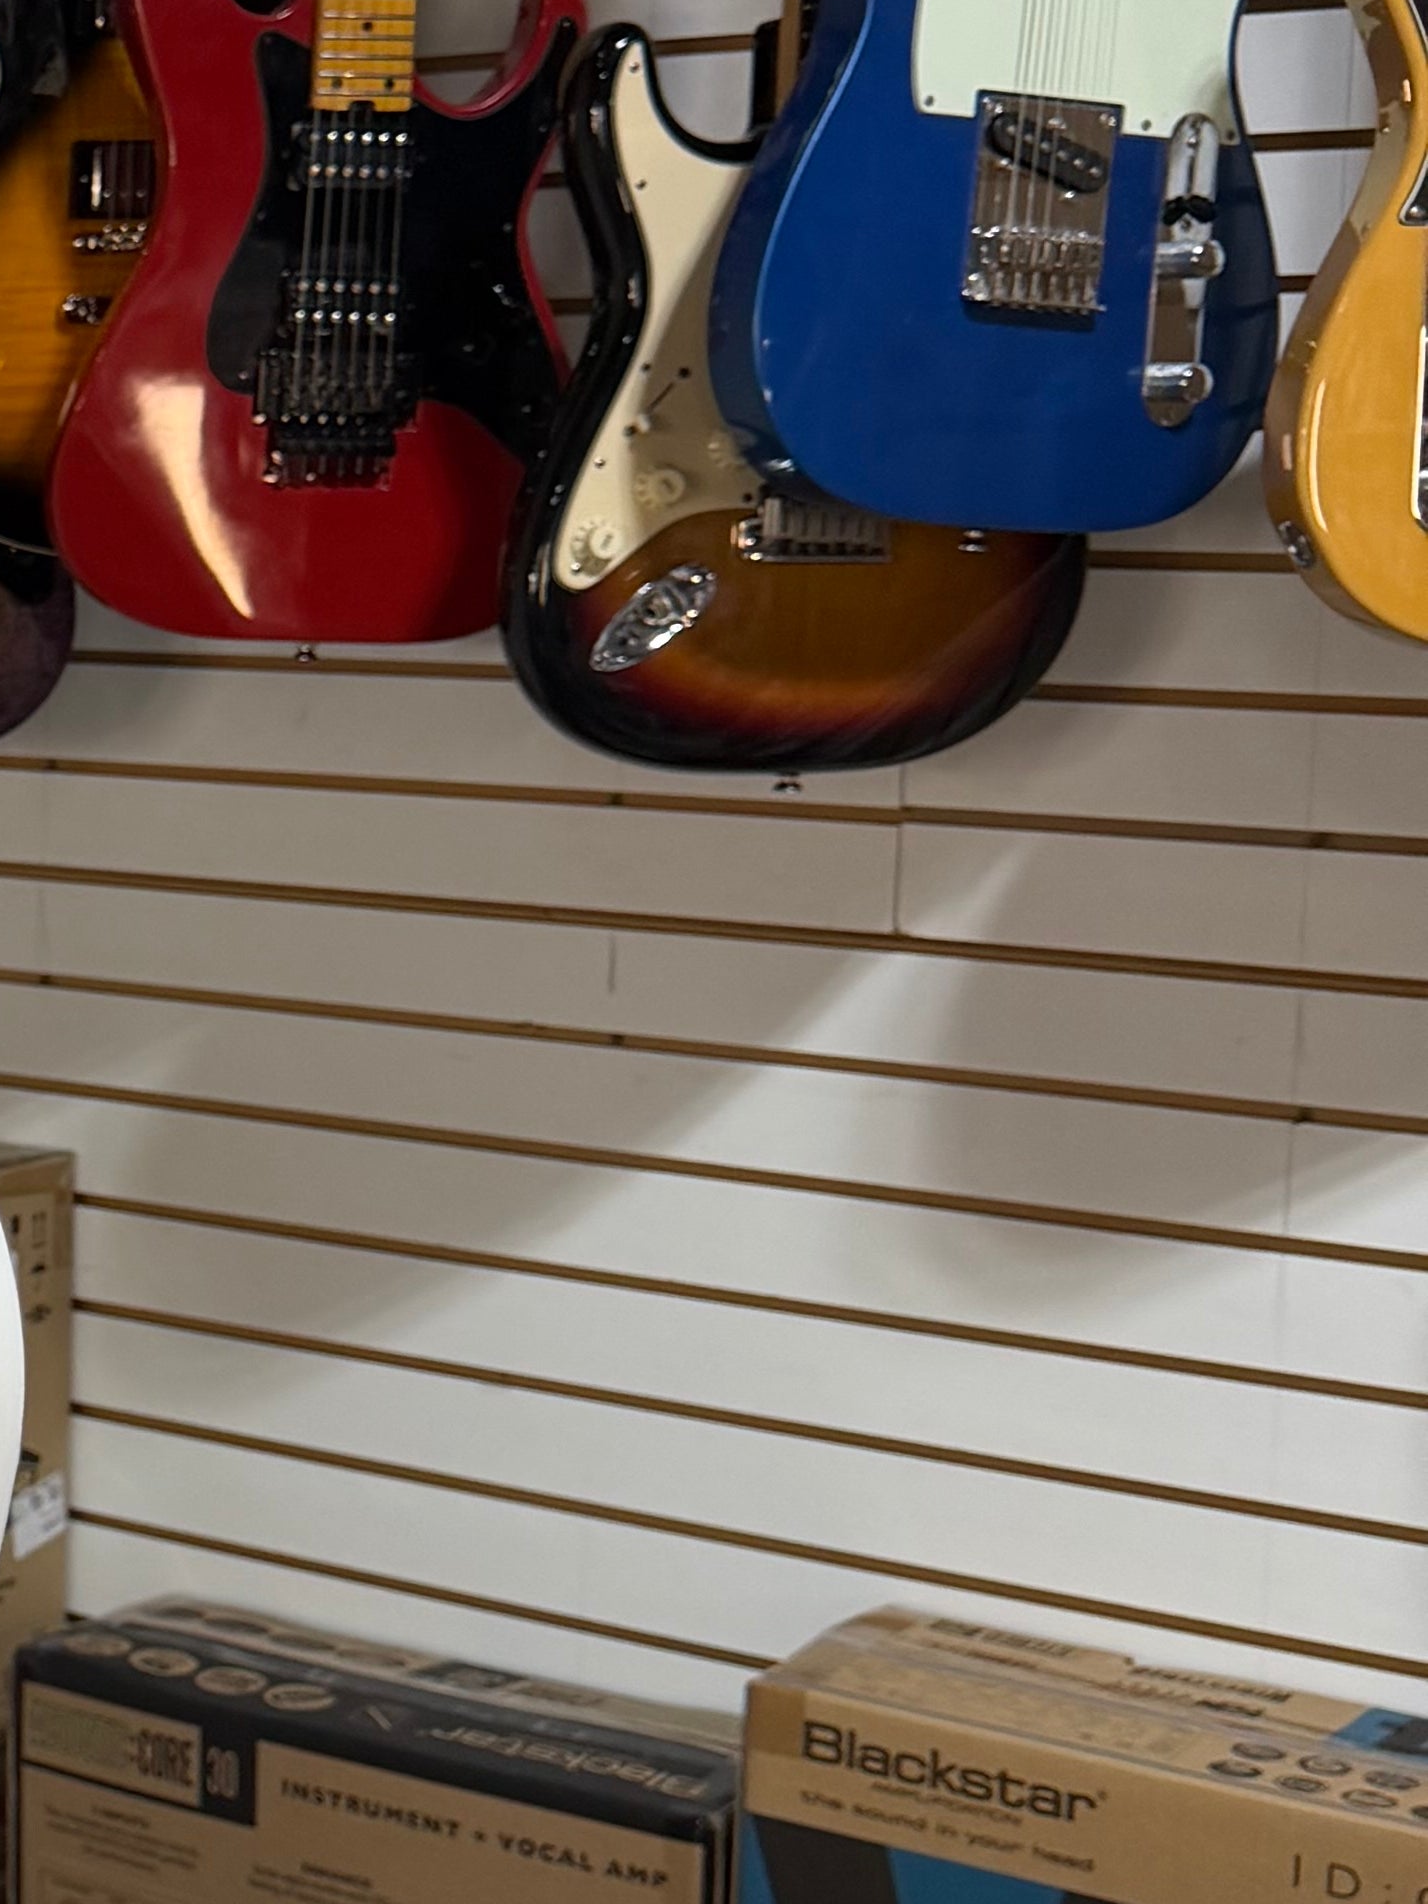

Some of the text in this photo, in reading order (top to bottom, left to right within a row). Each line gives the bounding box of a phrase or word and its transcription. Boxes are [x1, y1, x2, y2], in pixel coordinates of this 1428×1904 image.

[801, 1719, 1100, 1823] Blackstar
[280, 1777, 462, 1841] INSTRUMENT
[498, 1832, 593, 1874] VOCAL
[605, 1865, 670, 1891] AMP
[851, 1801, 928, 1834] sound
[935, 1819, 959, 1839] in
[964, 1827, 1021, 1858] your
[1030, 1840, 1098, 1874] head
